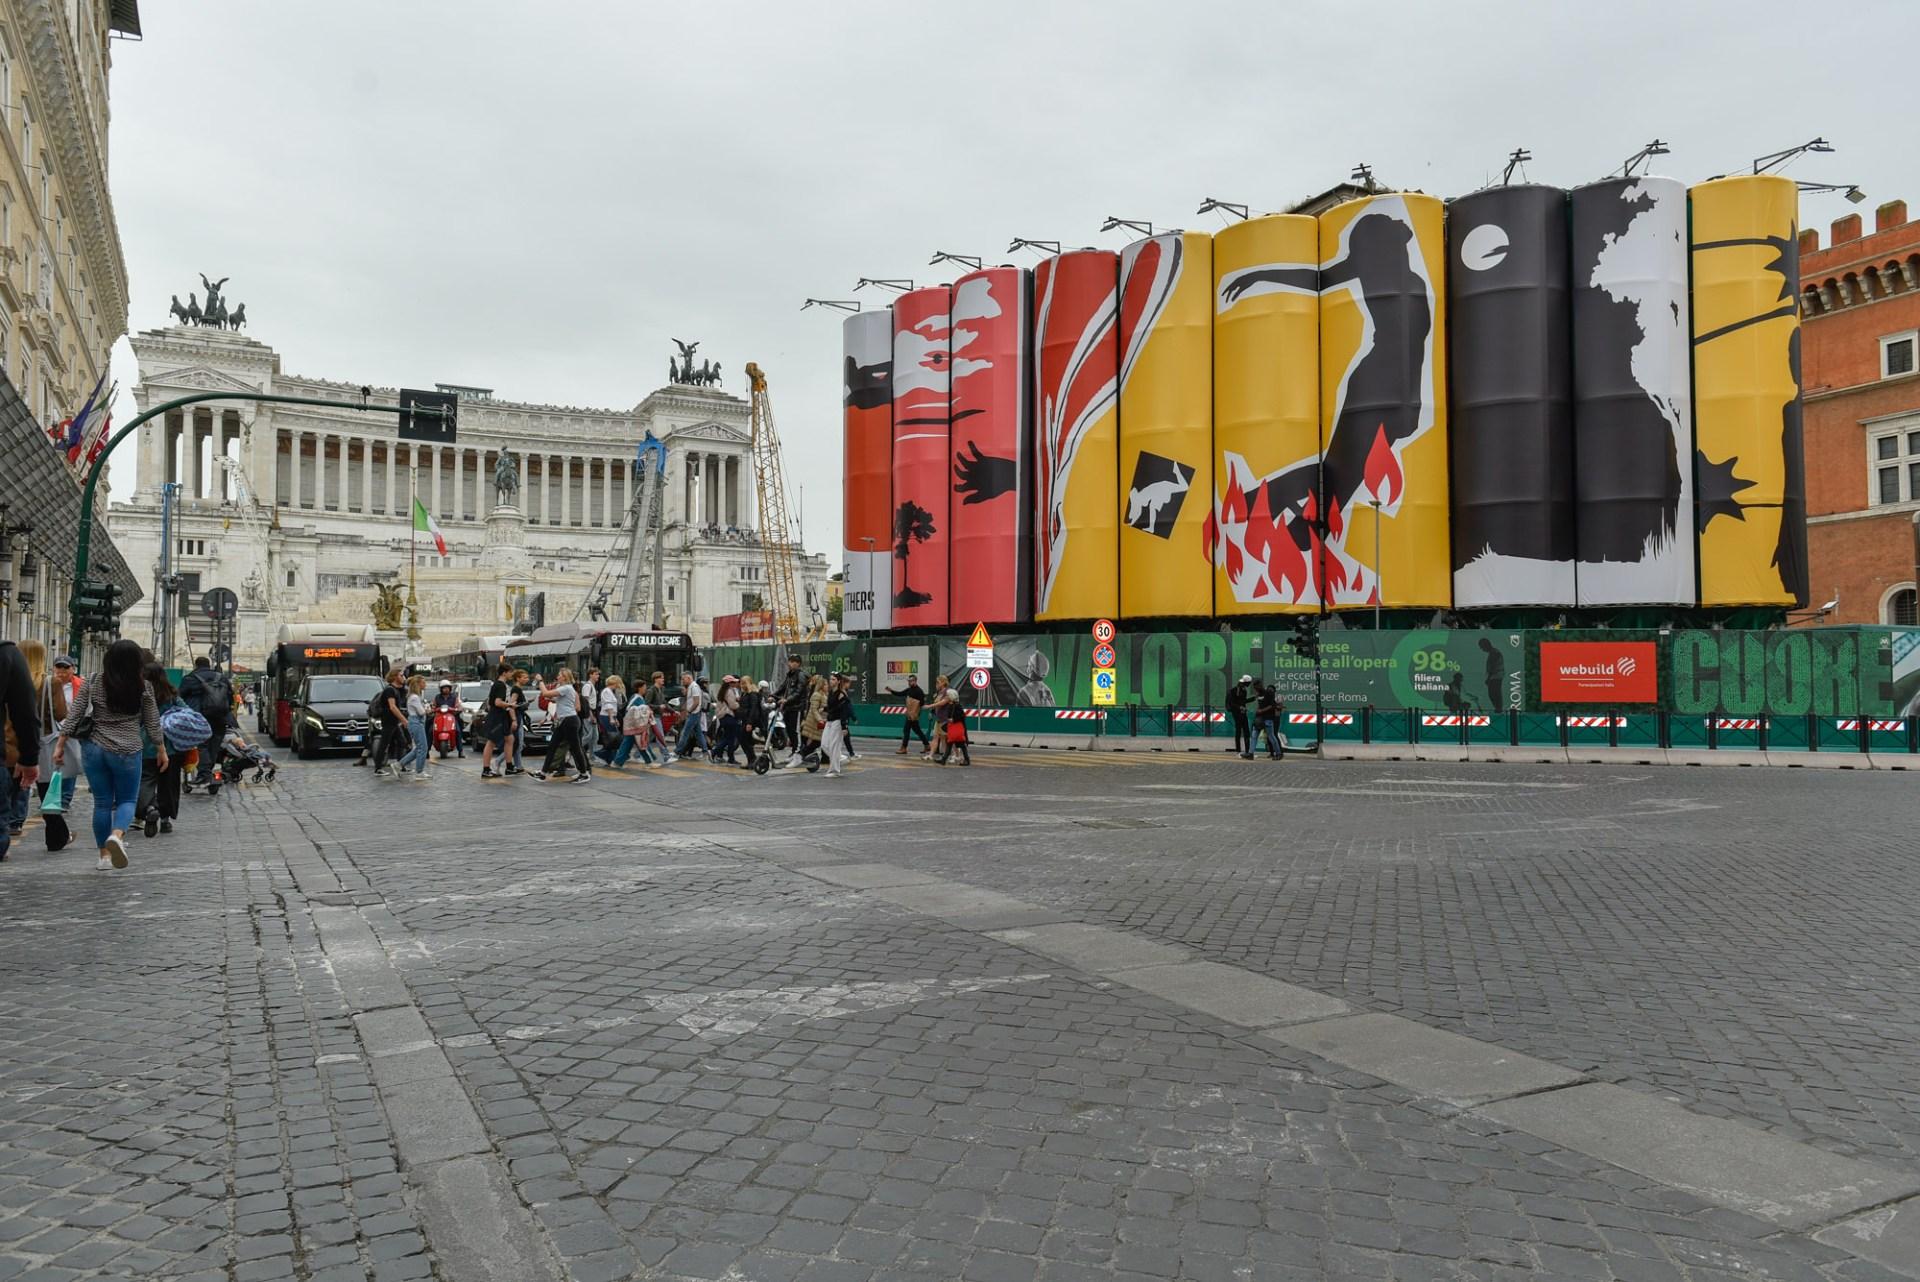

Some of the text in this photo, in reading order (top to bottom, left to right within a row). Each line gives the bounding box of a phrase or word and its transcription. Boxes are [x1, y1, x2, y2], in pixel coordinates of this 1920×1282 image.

[1097, 624, 1110, 637] 30
[611, 635, 624, 645] 87
[657, 636, 681, 645] CESARE
[1274, 641, 1350, 655] Le irese
[810, 652, 832, 661] centro
[1412, 650, 1460, 671] 98%
[836, 657, 850, 673] 85
[1332, 655, 1397, 671] all'opera
[1274, 671, 1340, 680] Le eccellnze
[1560, 664, 1614, 675] webuild
[1673, 630, 1895, 716] CUORE
[1414, 673, 1441, 682] filiera
[1414, 683, 1450, 691] italiana
[1510, 671, 1521, 710] ROMA
[1338, 692, 1368, 701] Roma
